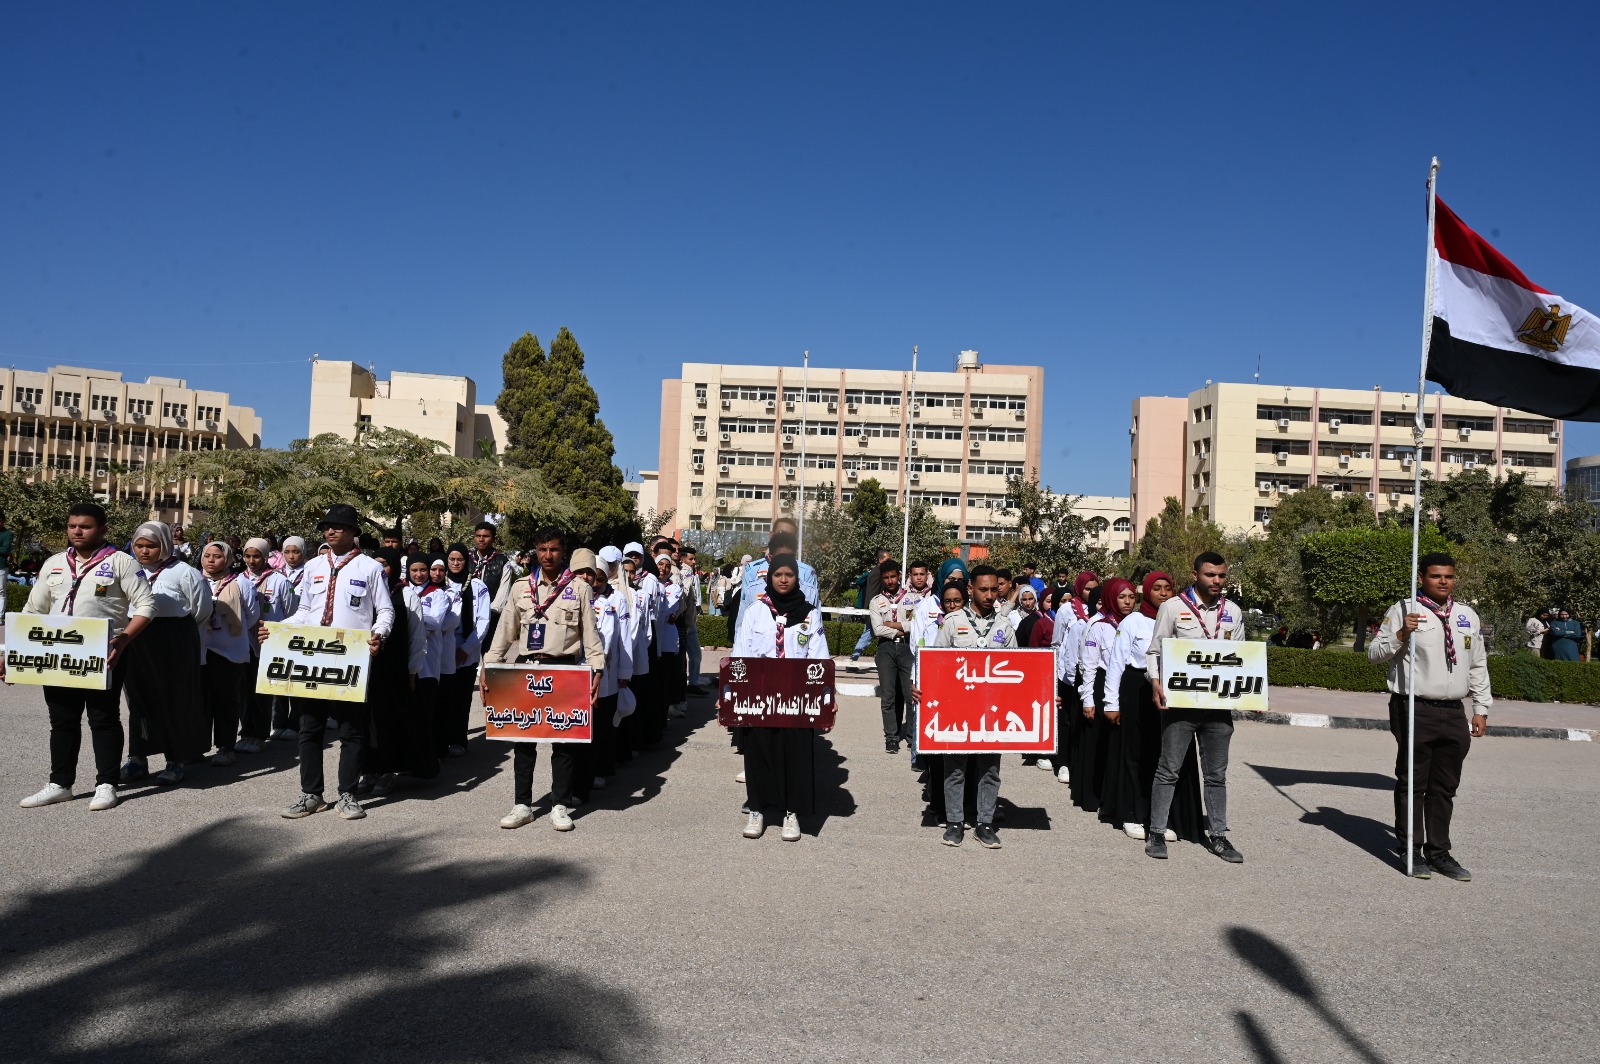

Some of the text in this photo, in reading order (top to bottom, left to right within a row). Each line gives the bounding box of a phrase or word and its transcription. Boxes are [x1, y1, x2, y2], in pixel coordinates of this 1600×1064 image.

[28, 627, 85, 646] كلية
[288, 635, 347, 656] كلية
[7, 650, 106, 677] التربية النوعية
[267, 656, 361, 690] الصيدلة
[955, 654, 1025, 691] كلية
[1186, 651, 1243, 669] كلية
[526, 674, 553, 698] كلية
[1168, 672, 1264, 699] الزراعة
[486, 706, 589, 730] التربية الرياضية
[732, 692, 822, 723] كلية الخدمة الاجتماعية
[924, 699, 1050, 743] الهندسة
